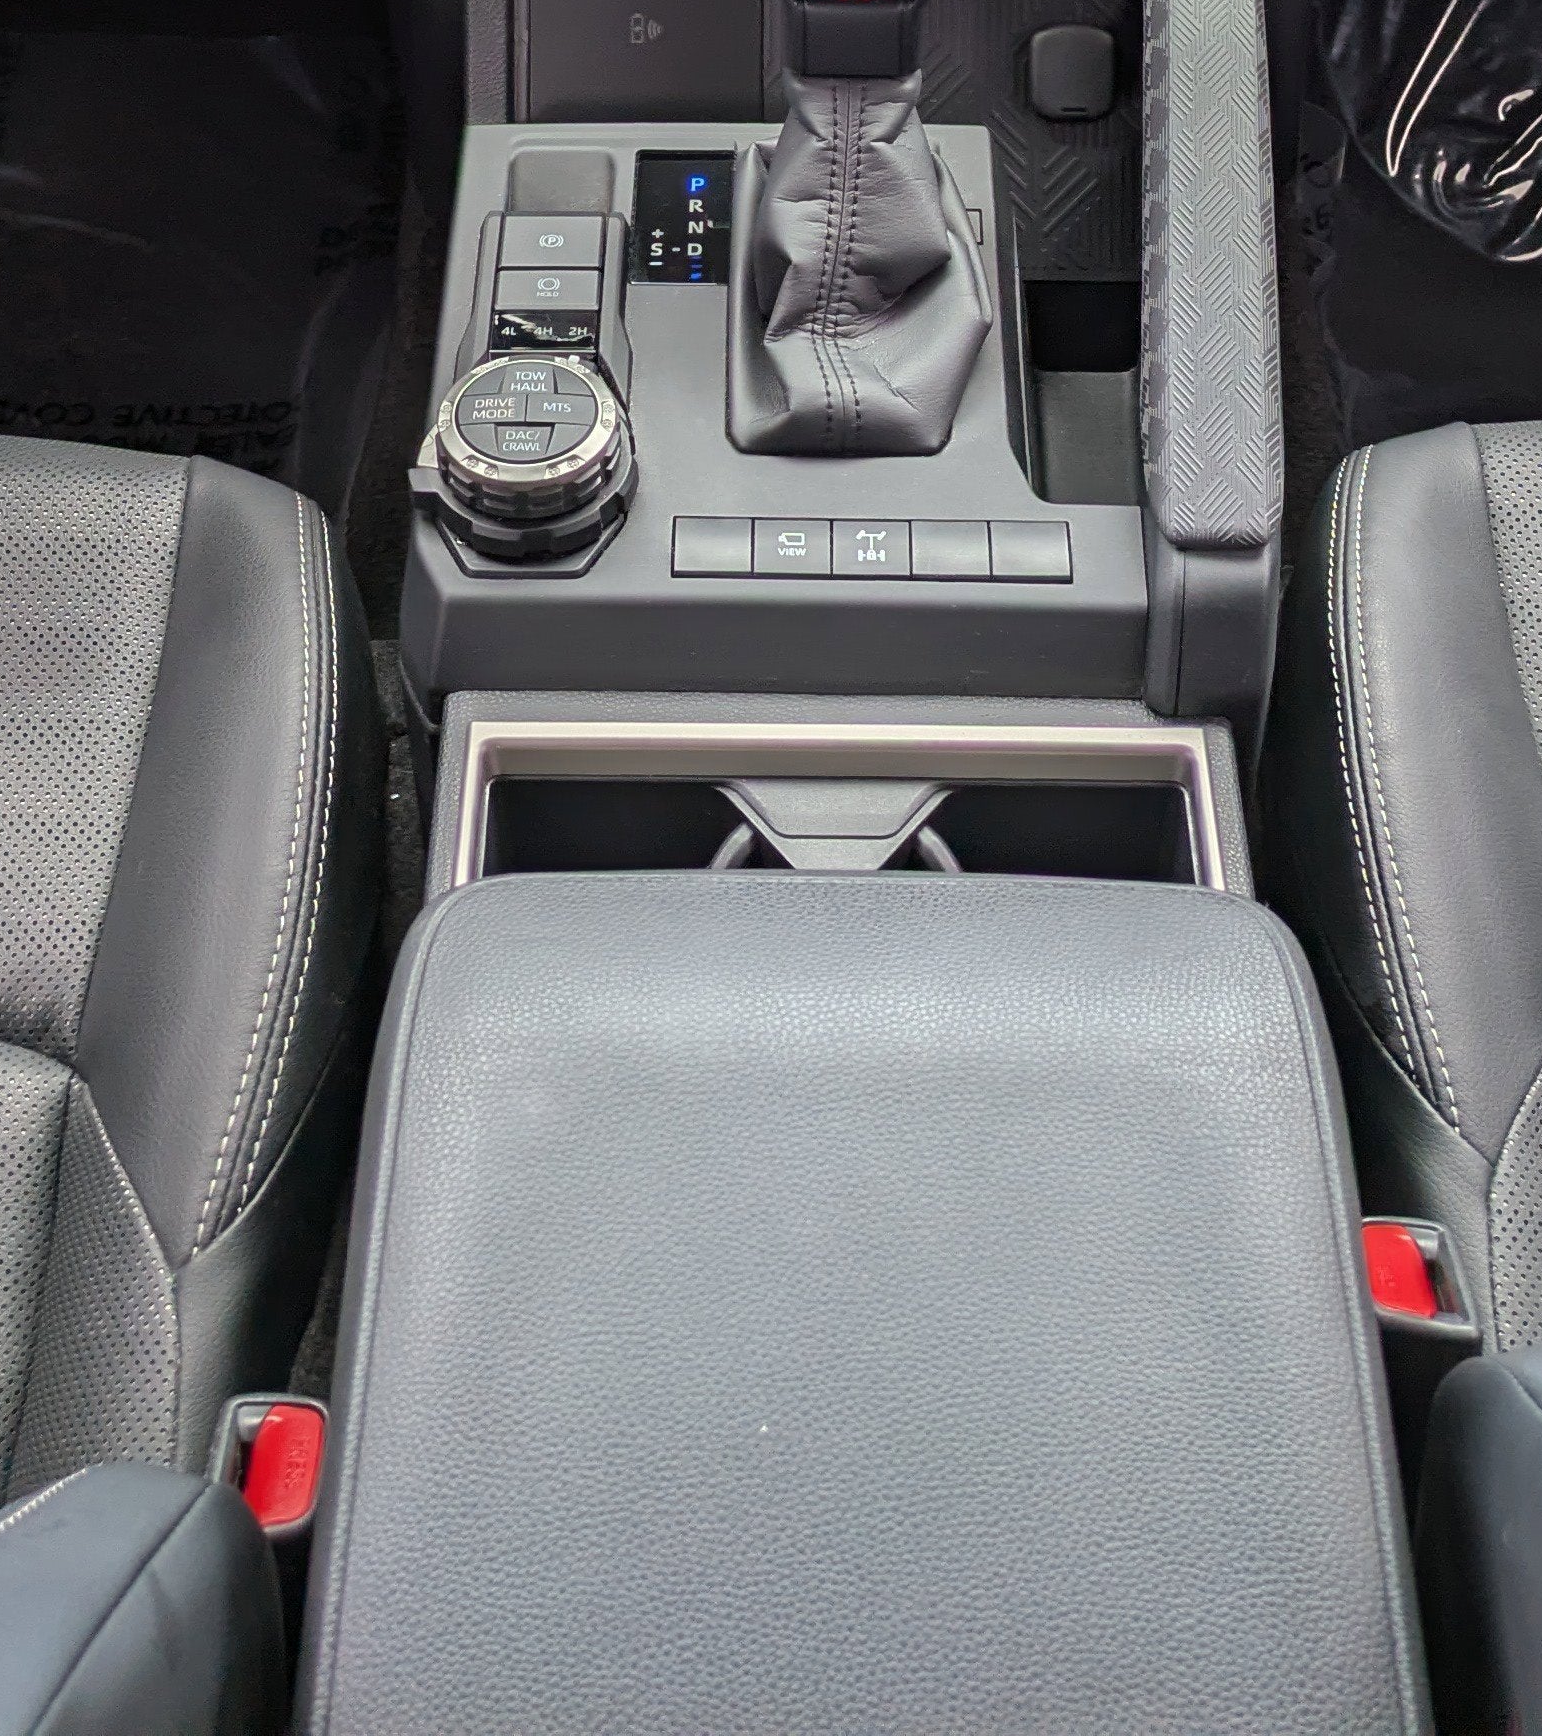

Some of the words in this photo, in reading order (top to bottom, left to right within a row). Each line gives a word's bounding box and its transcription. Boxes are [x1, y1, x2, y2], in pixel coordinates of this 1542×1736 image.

[690, 177, 705, 192] P
[688, 199, 704, 213] R
[688, 220, 704, 234] N
[650, 242, 663, 256] S
[687, 243, 703, 256] D
[536, 290, 559, 298] HOLD
[501, 326, 517, 336] 4L
[534, 326, 553, 336] 4H
[568, 326, 587, 336] 2H
[515, 371, 546, 381] TOW
[510, 382, 548, 392] HAUL
[474, 397, 516, 408] DRIVE
[543, 402, 572, 413] MTS
[472, 408, 516, 421] MODE
[505, 430, 540, 440] DAC/
[502, 441, 542, 452] CRAWL
[777, 546, 808, 557] VIEW
